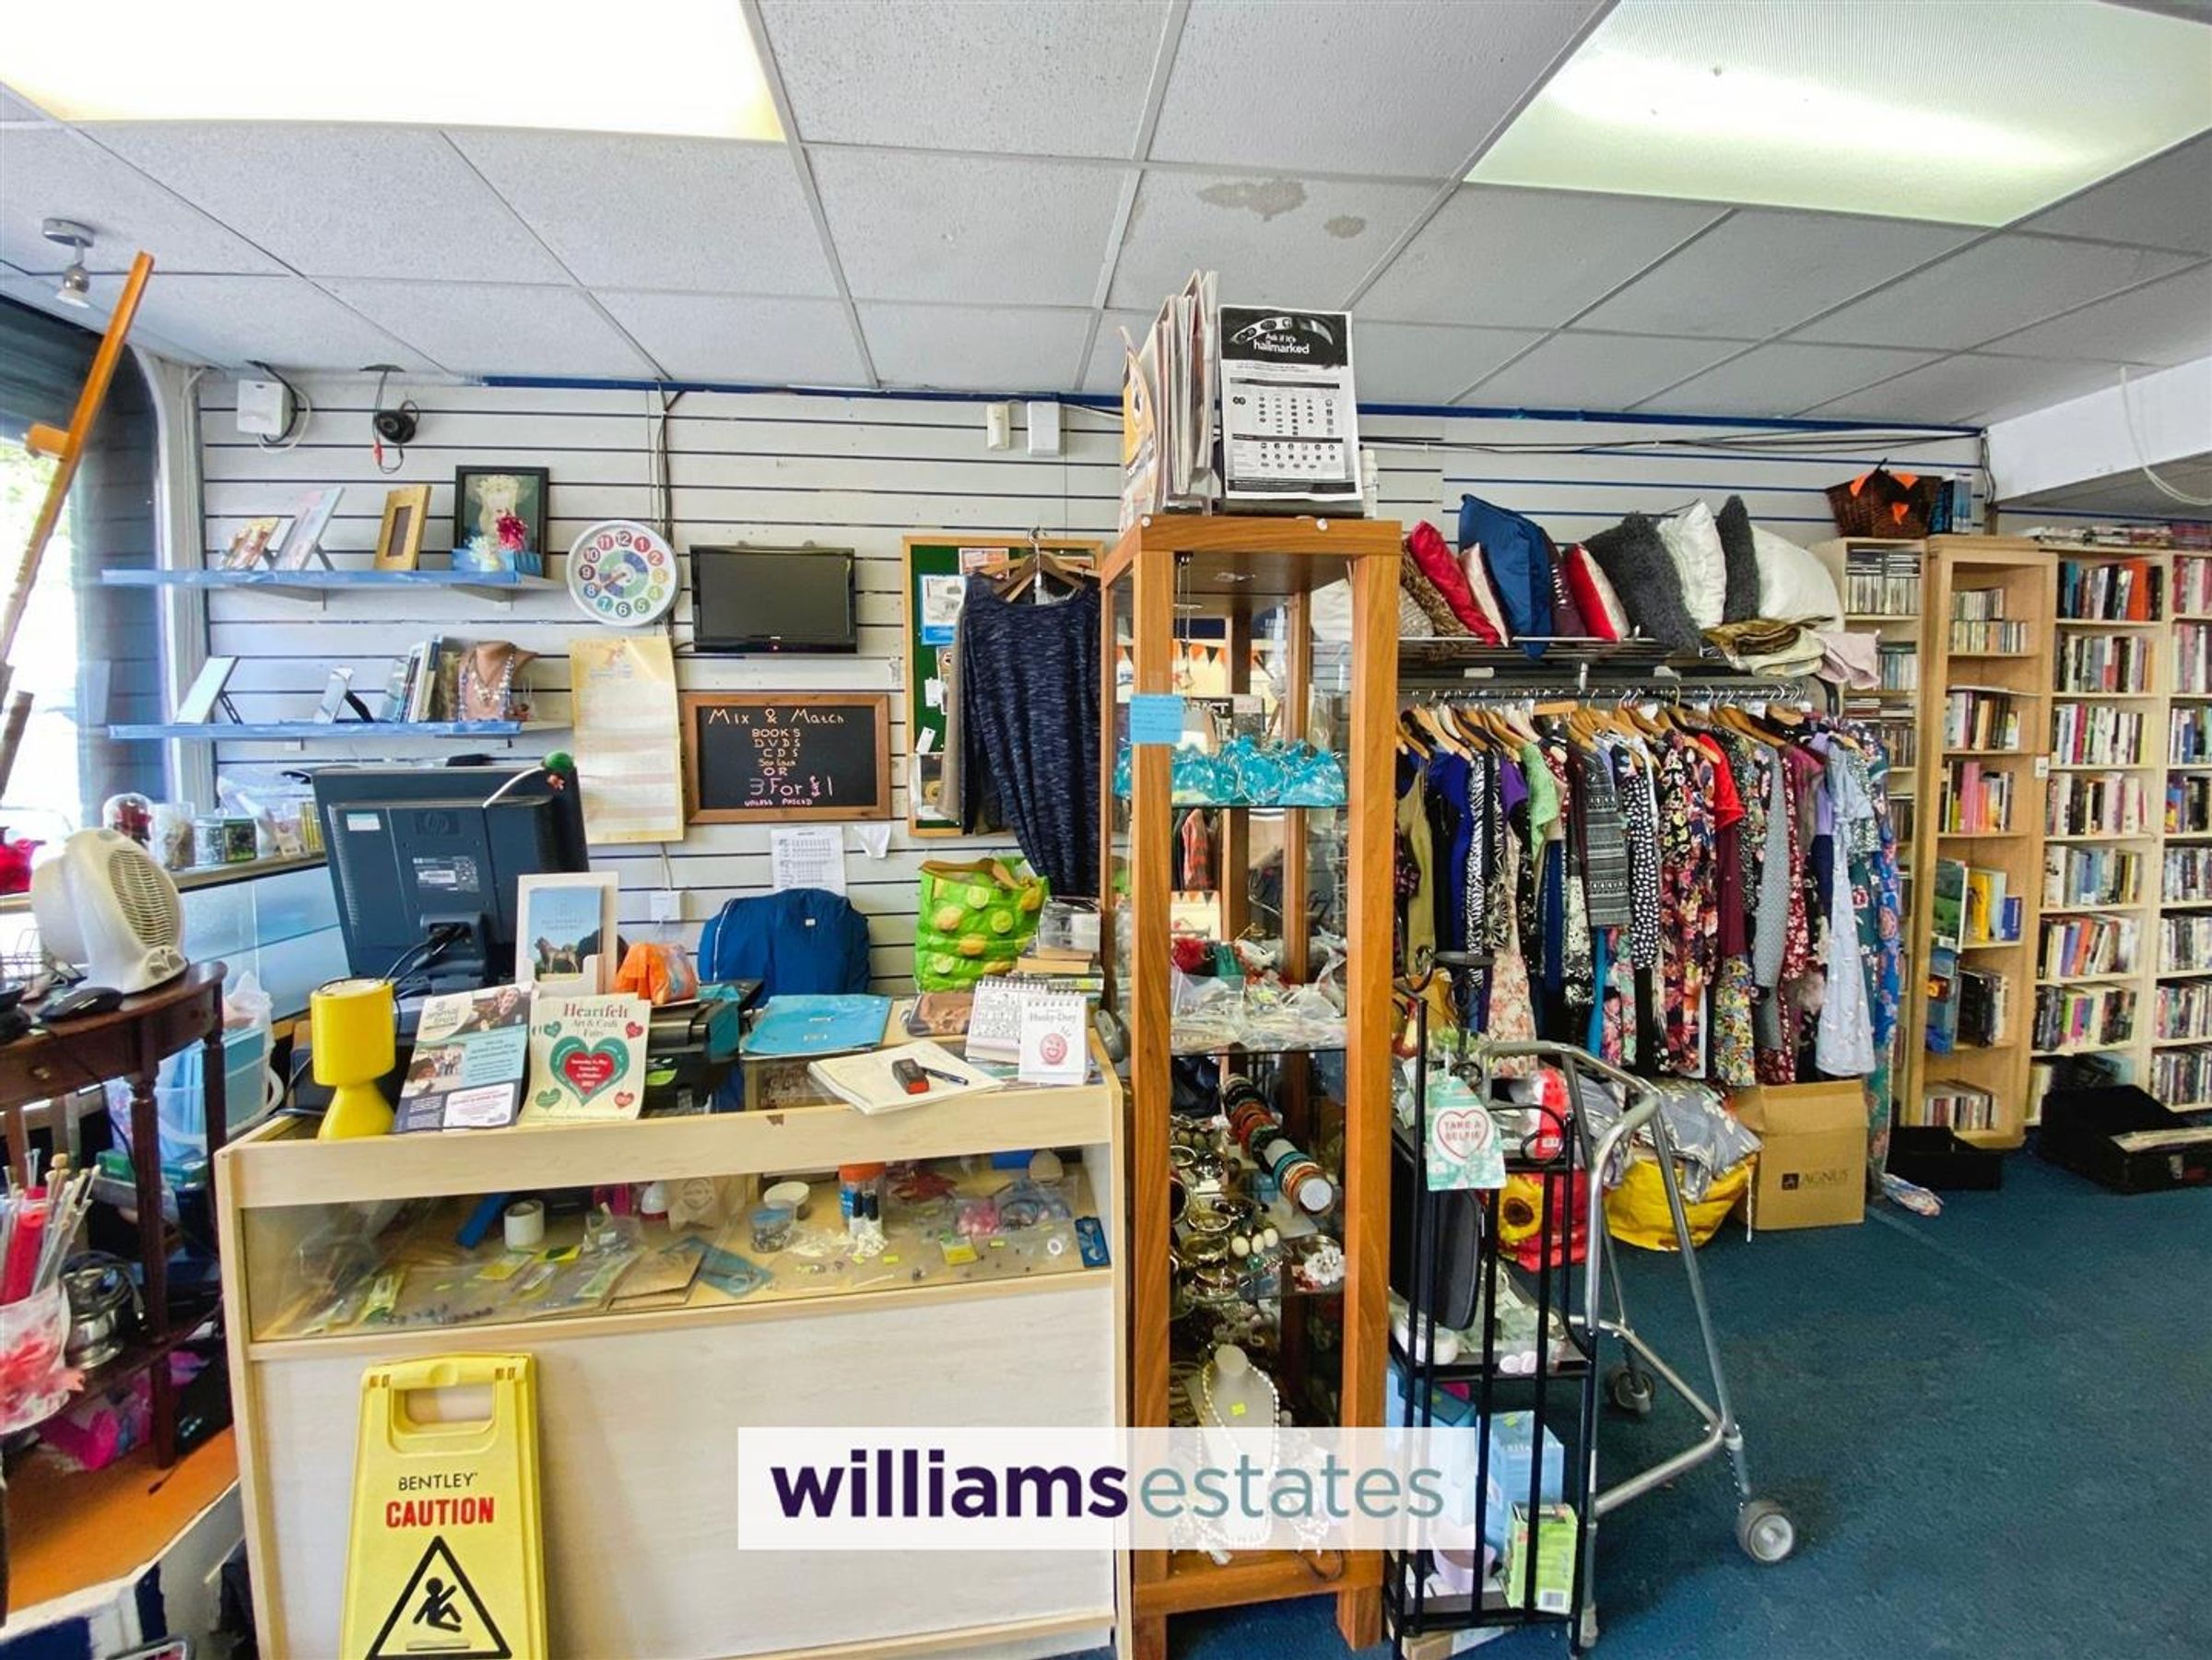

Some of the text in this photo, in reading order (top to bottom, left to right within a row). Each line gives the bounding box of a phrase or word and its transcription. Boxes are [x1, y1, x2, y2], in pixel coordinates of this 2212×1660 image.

[1253, 338, 1310, 355] hallmarked
[601, 535, 611, 549] 11
[616, 531, 630, 546] 12
[585, 548, 599, 562] 10
[651, 551, 661, 565] 2
[582, 566, 591, 580] 9
[655, 569, 665, 583] 3
[587, 583, 596, 597] 8
[650, 586, 660, 599] 4
[601, 598, 609, 611] 7
[618, 603, 628, 616] 6
[637, 599, 647, 612] 5
[708, 708, 750, 724] Mix
[764, 708, 778, 724] &
[751, 728, 801, 738] BOOKS
[754, 738, 801, 748] DVDS
[762, 748, 798, 758] CDS
[763, 767, 788, 776] OR
[749, 777, 765, 796] 3
[770, 777, 803, 796] For
[563, 1002, 629, 1018] Heartfelt
[397, 1473, 475, 1491] BENTLEY
[385, 1497, 495, 1528] CAUTION
